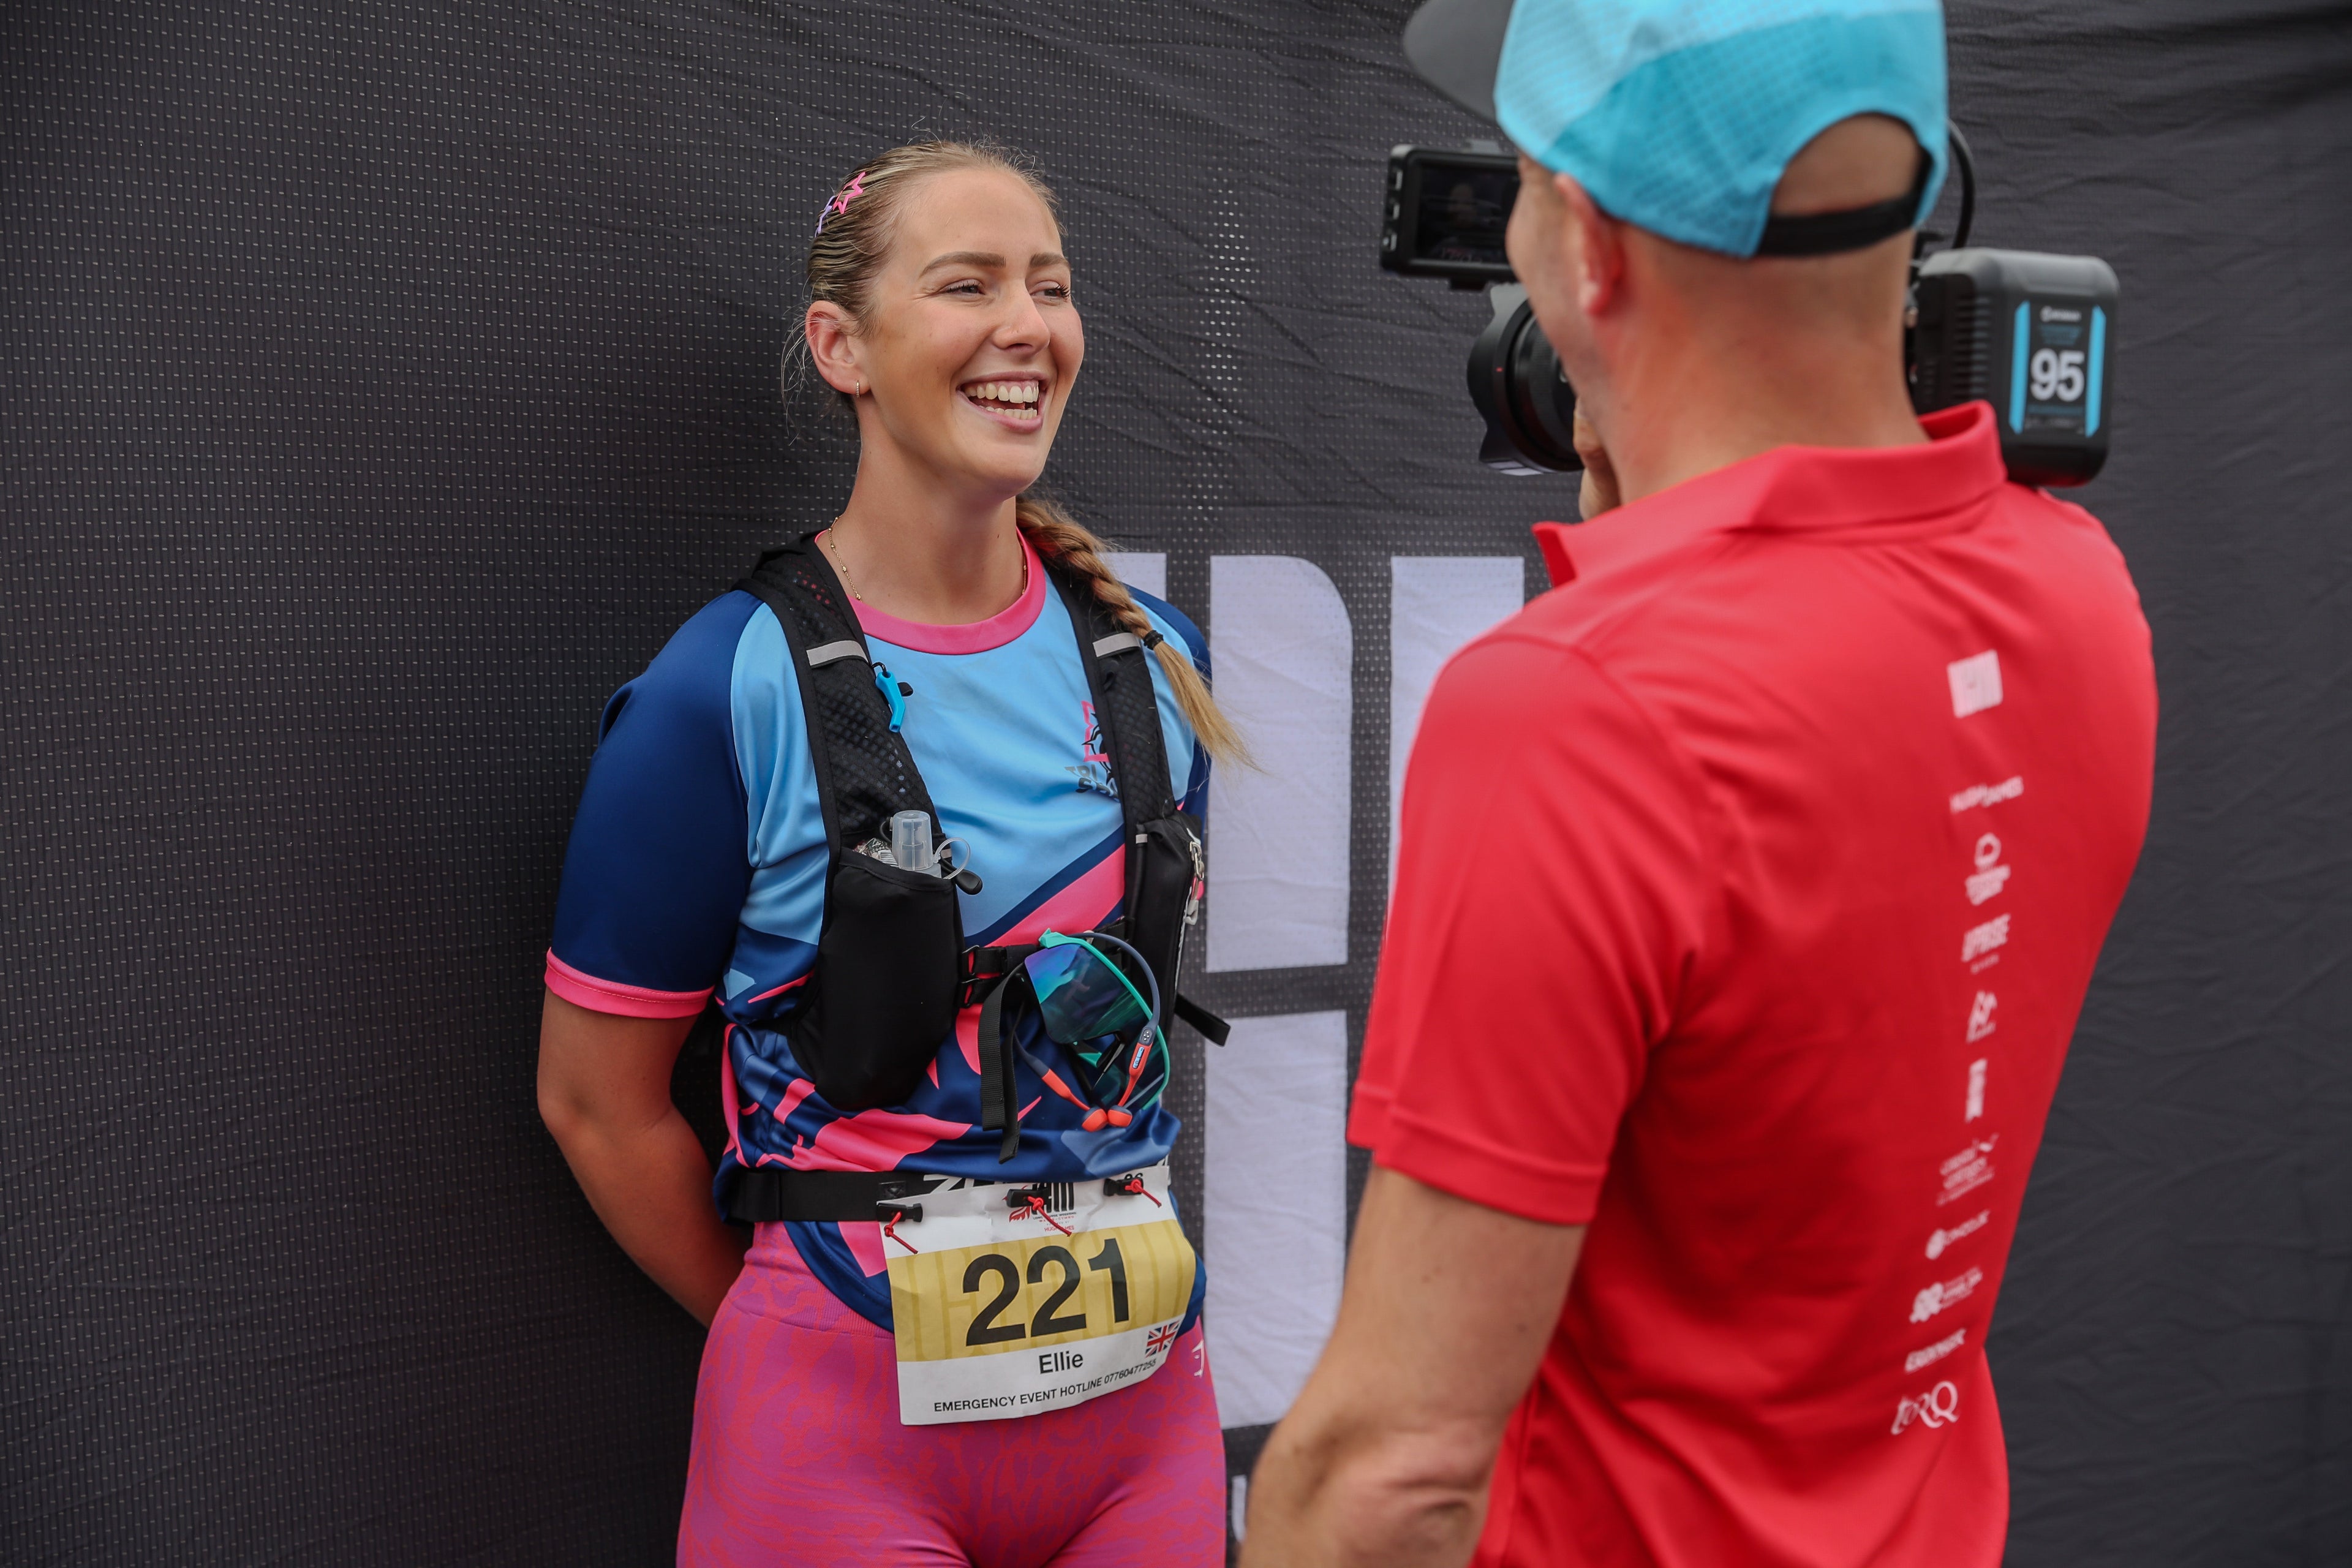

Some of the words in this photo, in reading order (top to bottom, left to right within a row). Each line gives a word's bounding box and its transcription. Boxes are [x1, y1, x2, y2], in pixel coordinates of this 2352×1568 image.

[2030, 348, 2085, 402] 95
[963, 1238, 1129, 1346] 221
[1039, 1352, 1084, 1374] Ellie
[934, 1395, 1016, 1412] EMERGENCY
[1020, 1389, 1057, 1404] EVENT
[1060, 1377, 1102, 1397] HOTLINE
